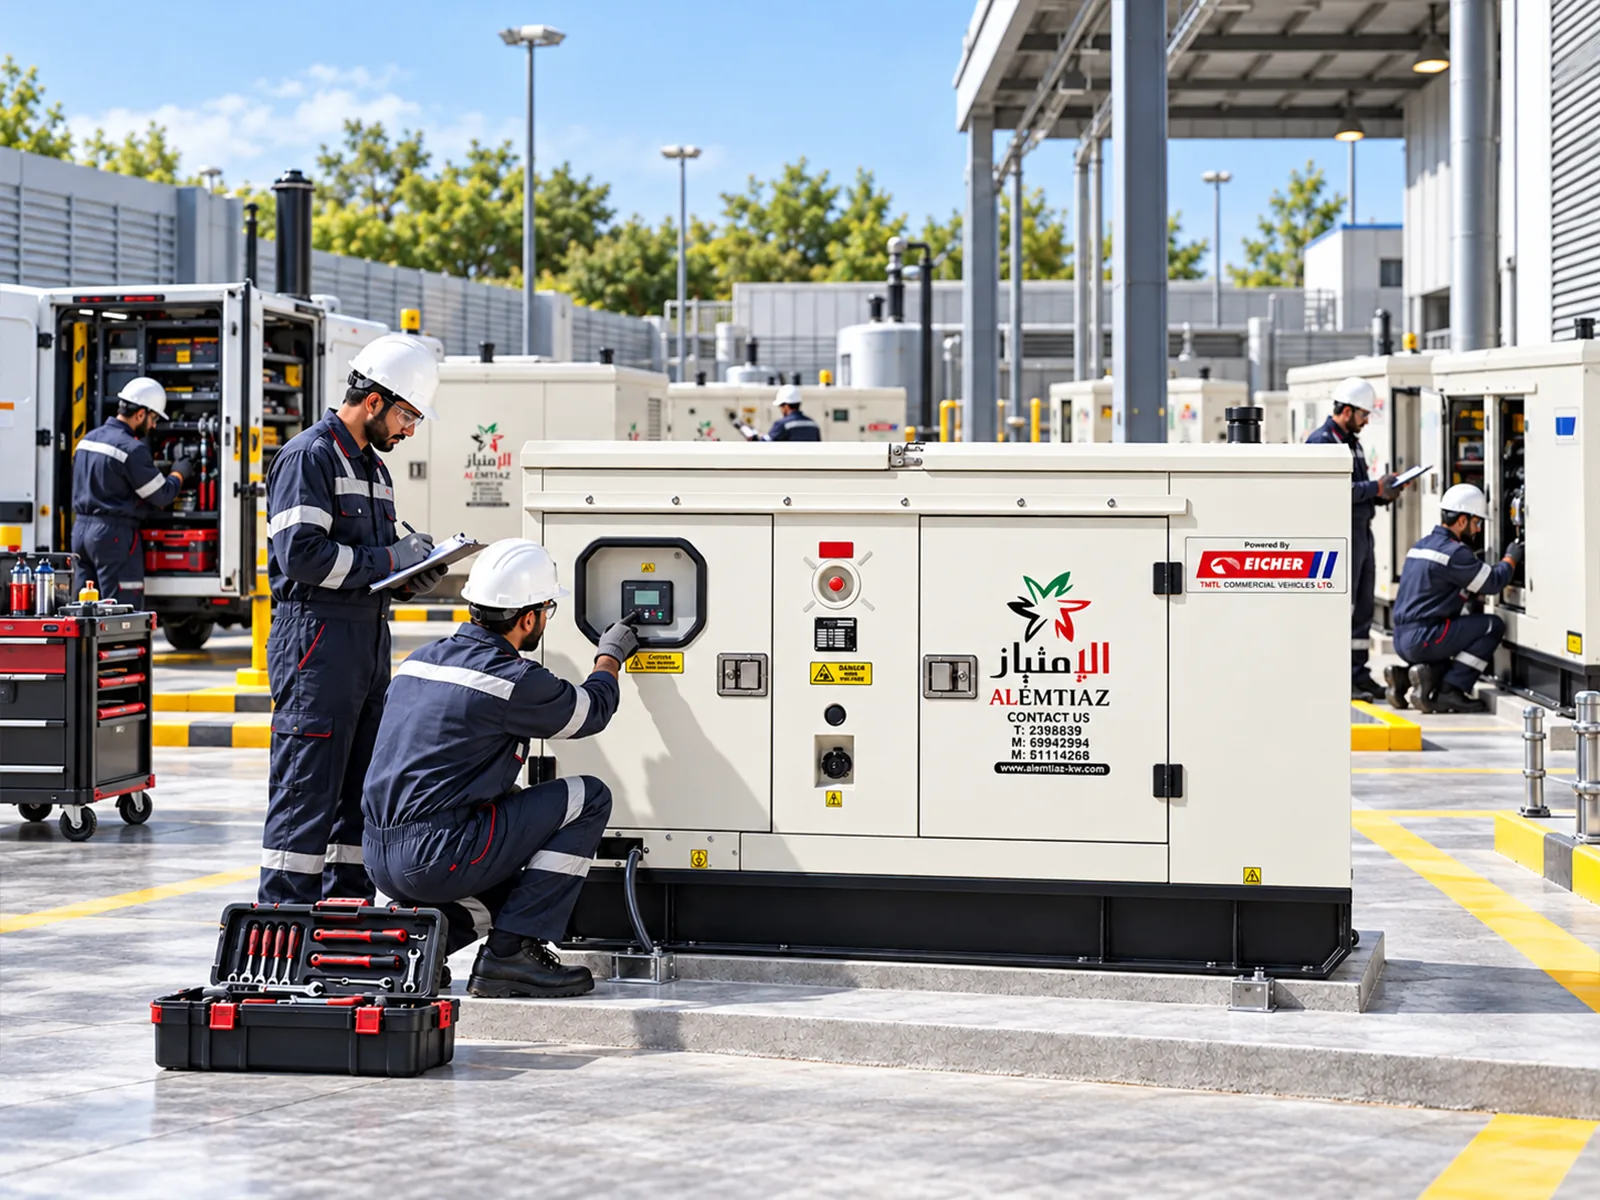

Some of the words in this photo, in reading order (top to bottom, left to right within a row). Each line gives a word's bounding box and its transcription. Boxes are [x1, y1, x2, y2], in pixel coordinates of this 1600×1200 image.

[1244, 541, 1278, 549] Powered
[1279, 541, 1290, 550] By
[1244, 557, 1304, 570] EICHER
[989, 688, 1110, 706] ALEMTIAZ
[1007, 712, 1070, 723] CONTACT
[1073, 712, 1090, 723] US
[1013, 725, 1025, 735] T:
[1029, 725, 1082, 736] 2398839
[1011, 737, 1026, 747] M:
[1029, 737, 1089, 748] 69942994
[1011, 749, 1026, 760] M:
